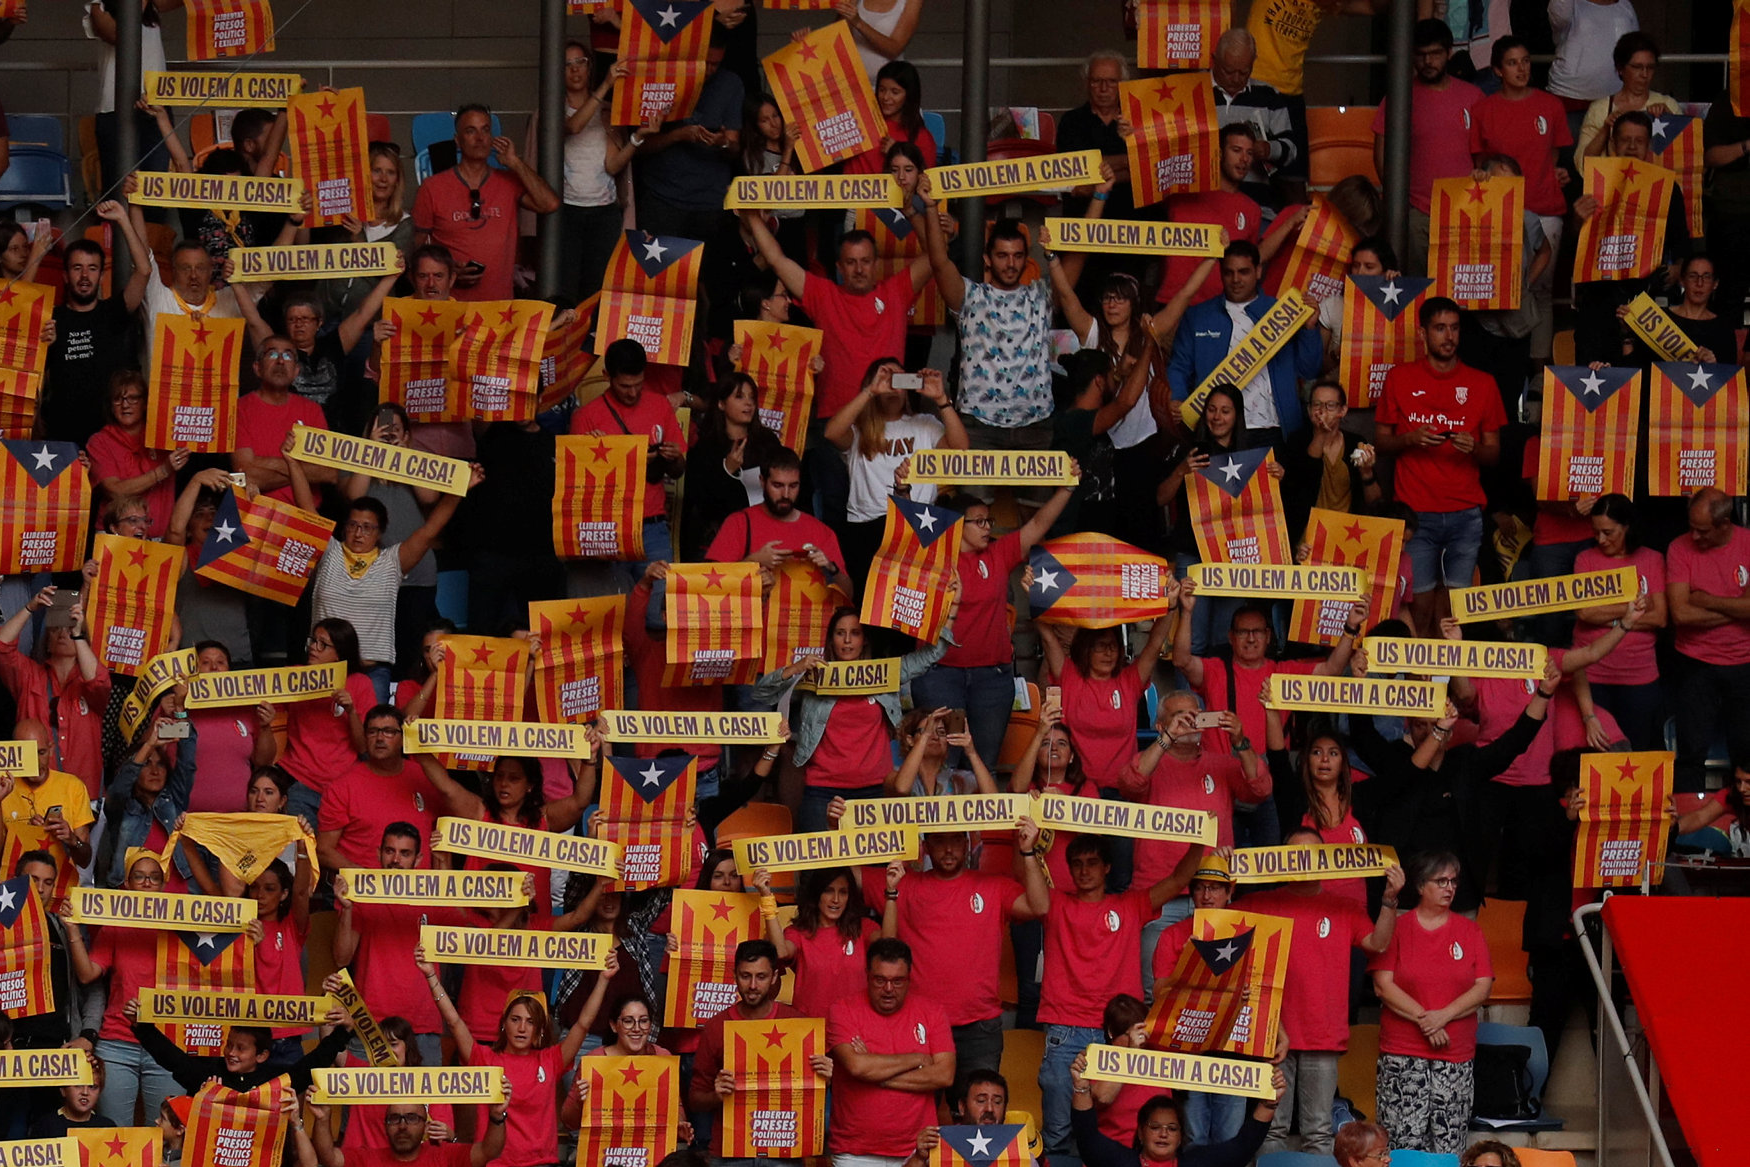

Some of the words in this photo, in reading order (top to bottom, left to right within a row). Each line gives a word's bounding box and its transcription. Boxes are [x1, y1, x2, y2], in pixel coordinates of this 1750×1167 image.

[241, 251, 262, 273] US
[266, 249, 319, 272] VOLEM
[324, 248, 335, 269] A
[339, 246, 384, 269] CASA!
[1409, 412, 1434, 423] Hotel
[1436, 413, 1466, 430] Piqué
[303, 431, 327, 455] US
[331, 437, 387, 468] VOLEM
[388, 451, 401, 472] A
[405, 454, 456, 484] CASA!
[1680, 450, 1715, 458] LLIBERTAT
[916, 454, 936, 475] US
[941, 454, 995, 476] VOLEM
[1000, 455, 1011, 476] A
[1015, 455, 1063, 476] CASA!
[1680, 459, 1714, 468] PRESOS
[1684, 478, 1714, 486] EXILIATS
[1603, 841, 1642, 849] LLIBERTAT
[1602, 850, 1641, 860] PRESES
[435, 931, 458, 954] US
[463, 932, 522, 957] VOLEM
[527, 935, 539, 958] A
[544, 936, 596, 960] CASA!
[1097, 1049, 1120, 1072] US
[1126, 1053, 1186, 1080] VOLEM
[1190, 1060, 1202, 1082] A
[1208, 1062, 1261, 1089] CASA!
[753, 1111, 795, 1119] LLIBERTAT
[753, 1120, 795, 1130] PRESES
